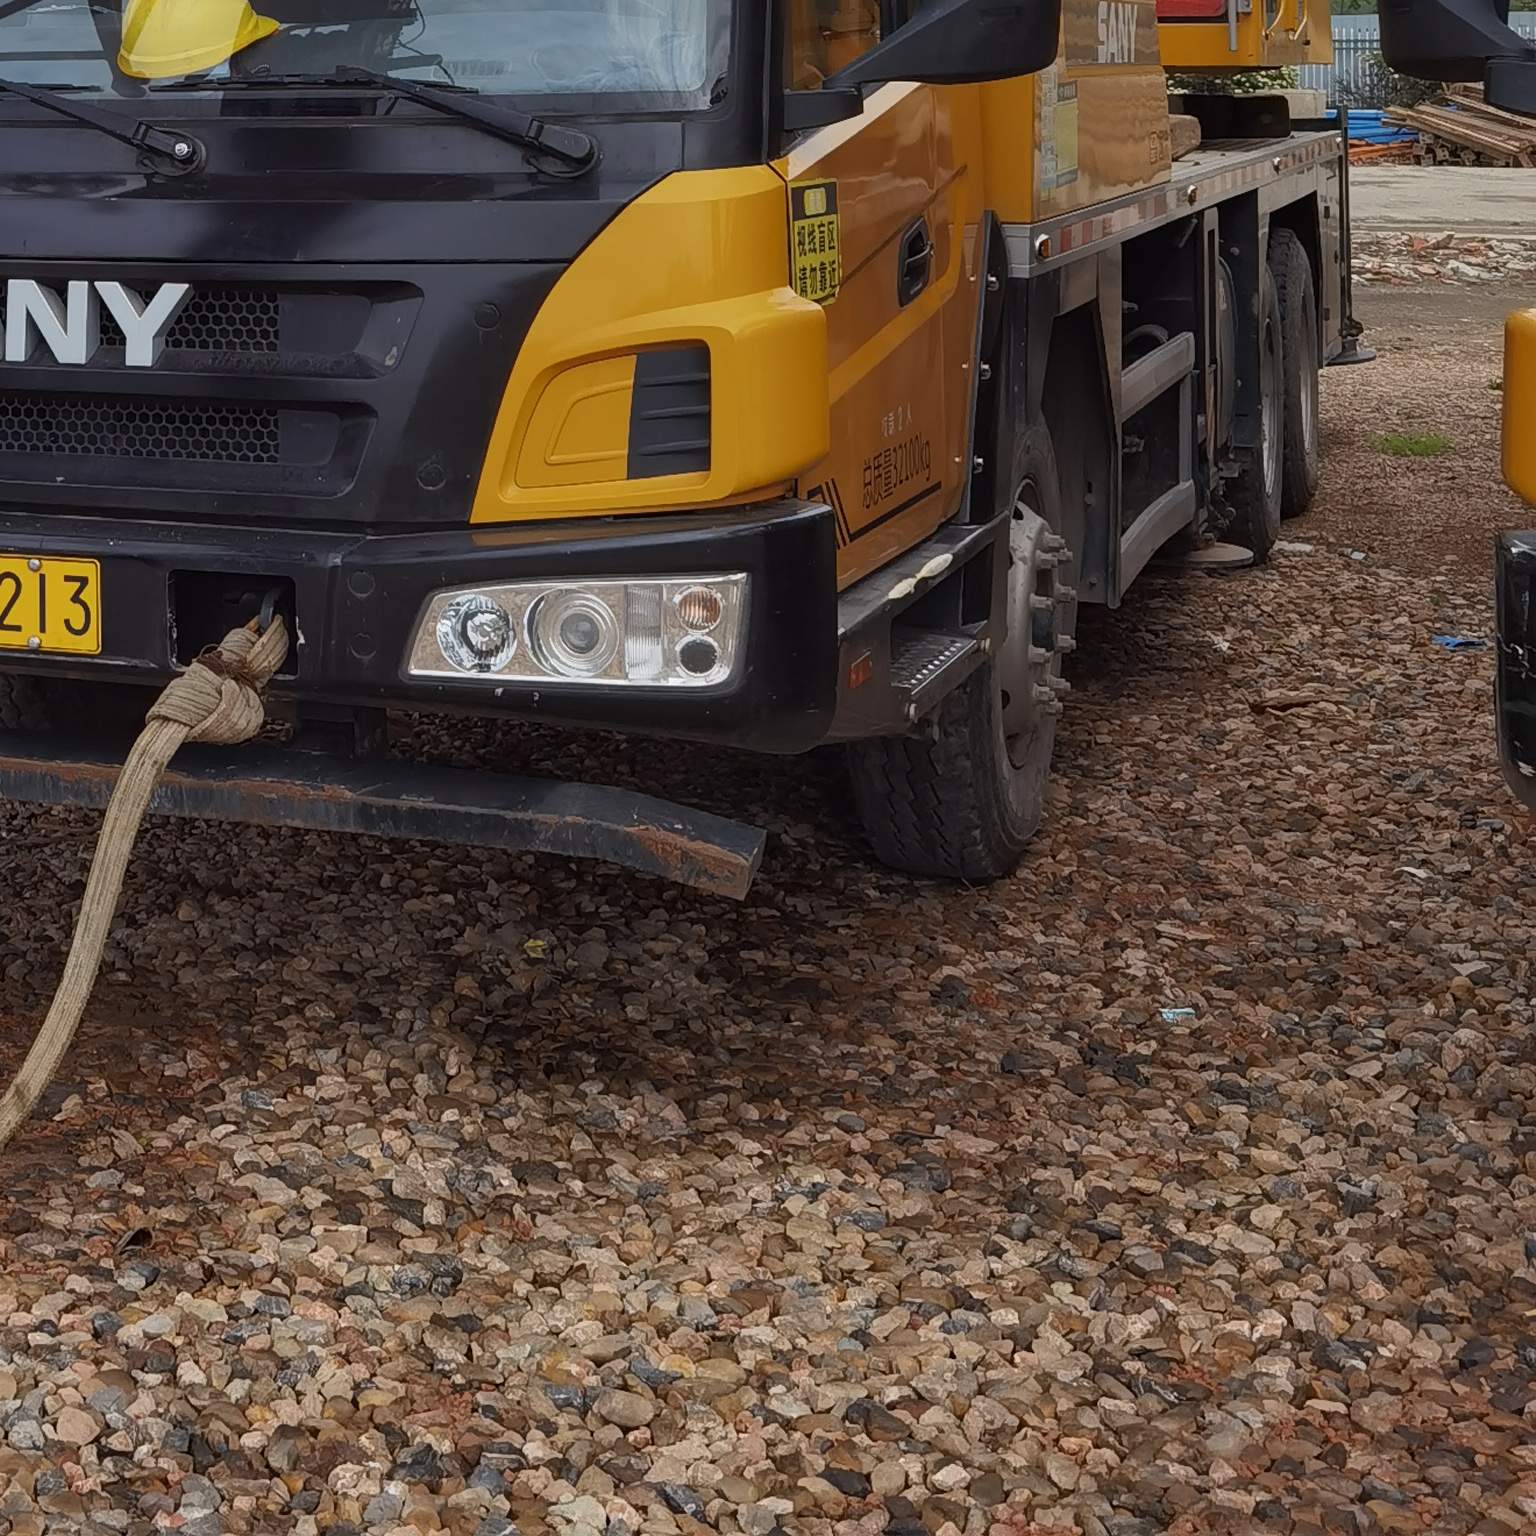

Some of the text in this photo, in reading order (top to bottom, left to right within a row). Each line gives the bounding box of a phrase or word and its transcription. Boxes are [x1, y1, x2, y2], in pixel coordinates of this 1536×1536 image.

[1097, 0, 1138, 64] SANY
[797, 220, 836, 257] 视线盲区
